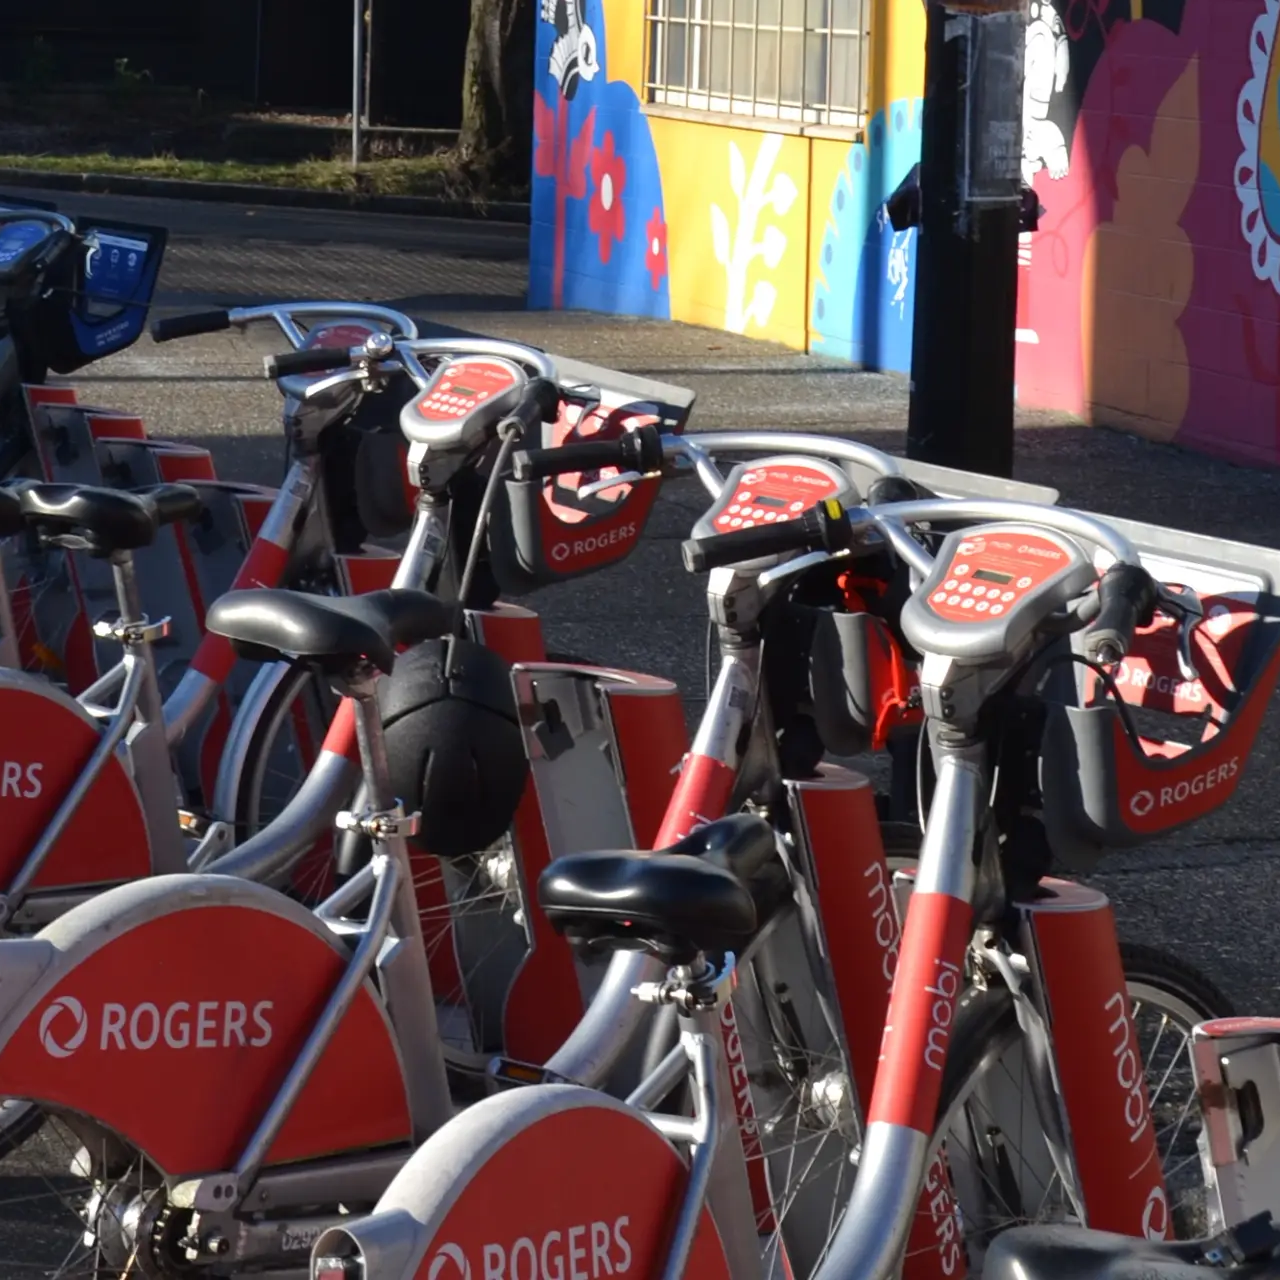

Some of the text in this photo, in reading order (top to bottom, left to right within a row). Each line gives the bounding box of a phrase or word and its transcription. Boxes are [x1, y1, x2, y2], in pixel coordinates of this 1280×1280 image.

[573, 523, 636, 556] ROGERS
[1131, 667, 1203, 703] ROGERS
[1159, 756, 1239, 807] ROGERS
[100, 1000, 273, 1051] ROGERS
[924, 958, 960, 1071] mobi
[1104, 992, 1150, 1143] mobi
[483, 1216, 632, 1280] ROGERS
